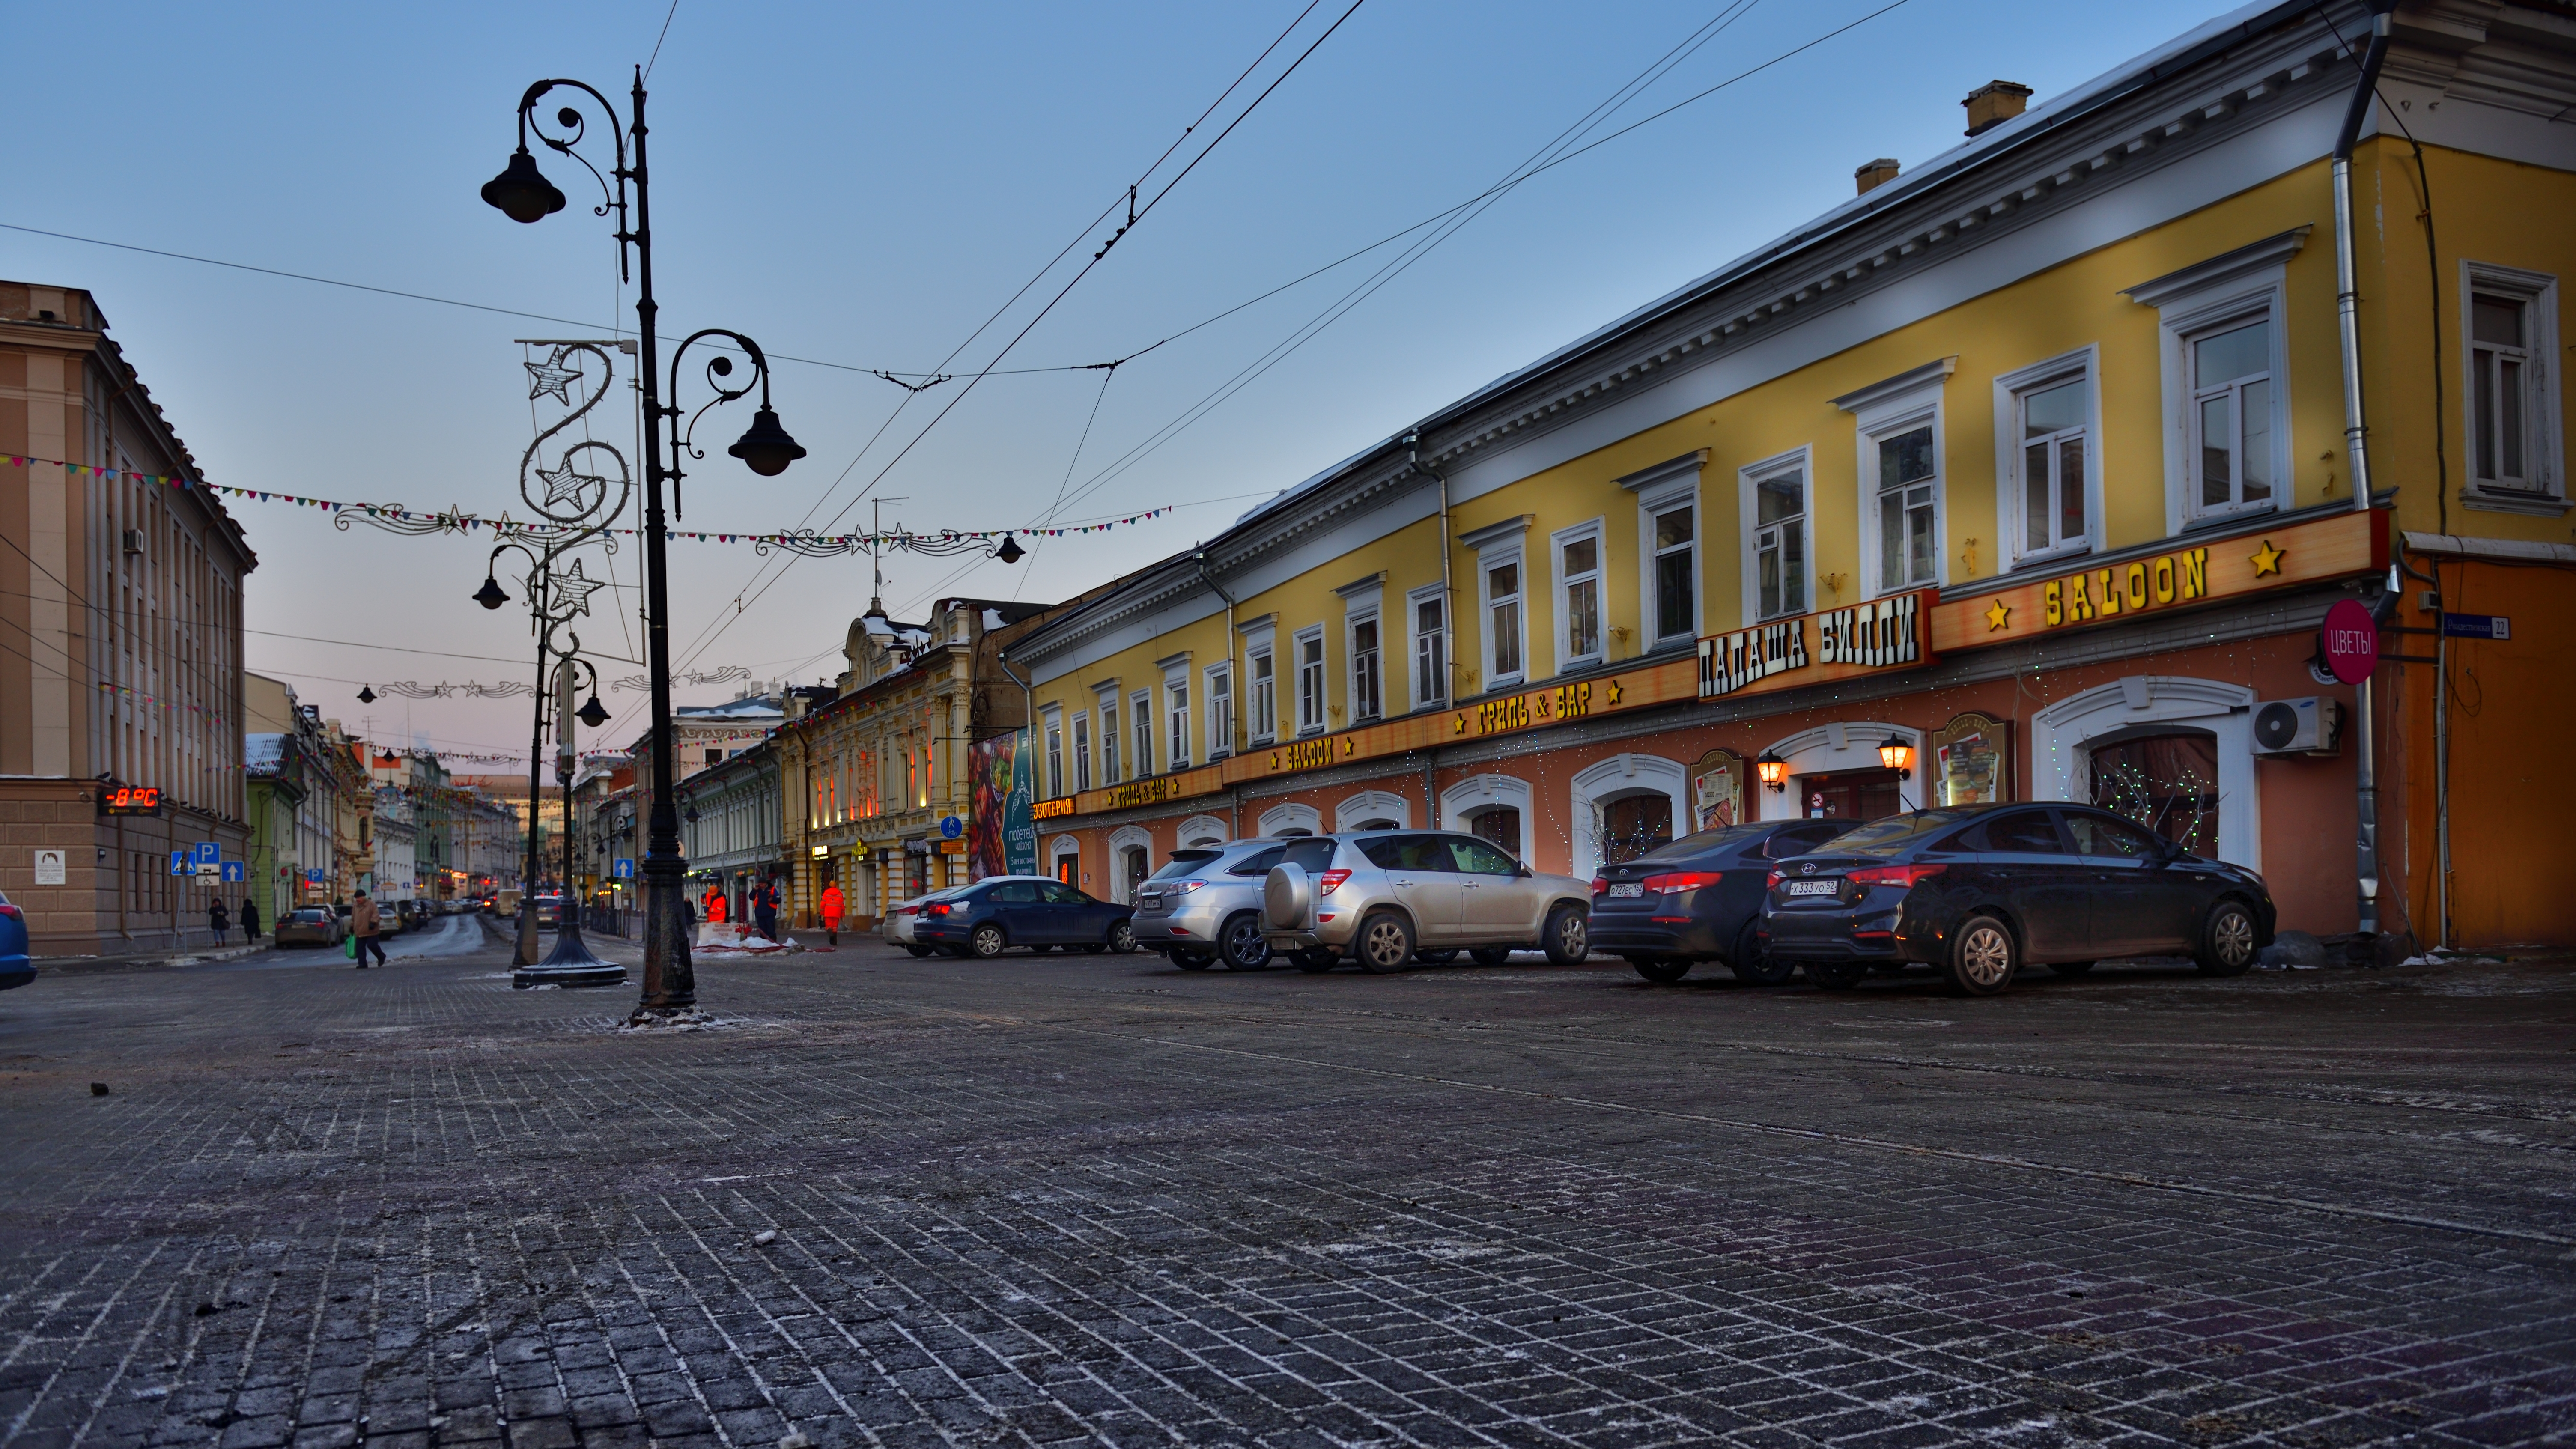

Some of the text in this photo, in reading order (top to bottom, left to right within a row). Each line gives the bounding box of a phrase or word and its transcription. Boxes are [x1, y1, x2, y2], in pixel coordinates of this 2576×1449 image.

[2045, 548, 2208, 626] SALOON
[2448, 619, 2504, 635] Рождественская 22
[1697, 594, 1919, 697] ПАПАША БИЛЛИ
[2331, 630, 2371, 656] ЦВЕТЫ
[1477, 683, 1591, 734] ГРИЛЬ & БАР
[1951, 719, 1988, 734] GRILL BAR
[1287, 737, 1333, 770] SALOON
[1707, 754, 1726, 764] SALOON
[1118, 779, 1166, 807] ГРИЛЬ & БАР
[1033, 798, 1071, 820] ЭЗОТЕРИЯ
[1009, 826, 1034, 841] тюбетей
[1826, 881, 1834, 889] 52
